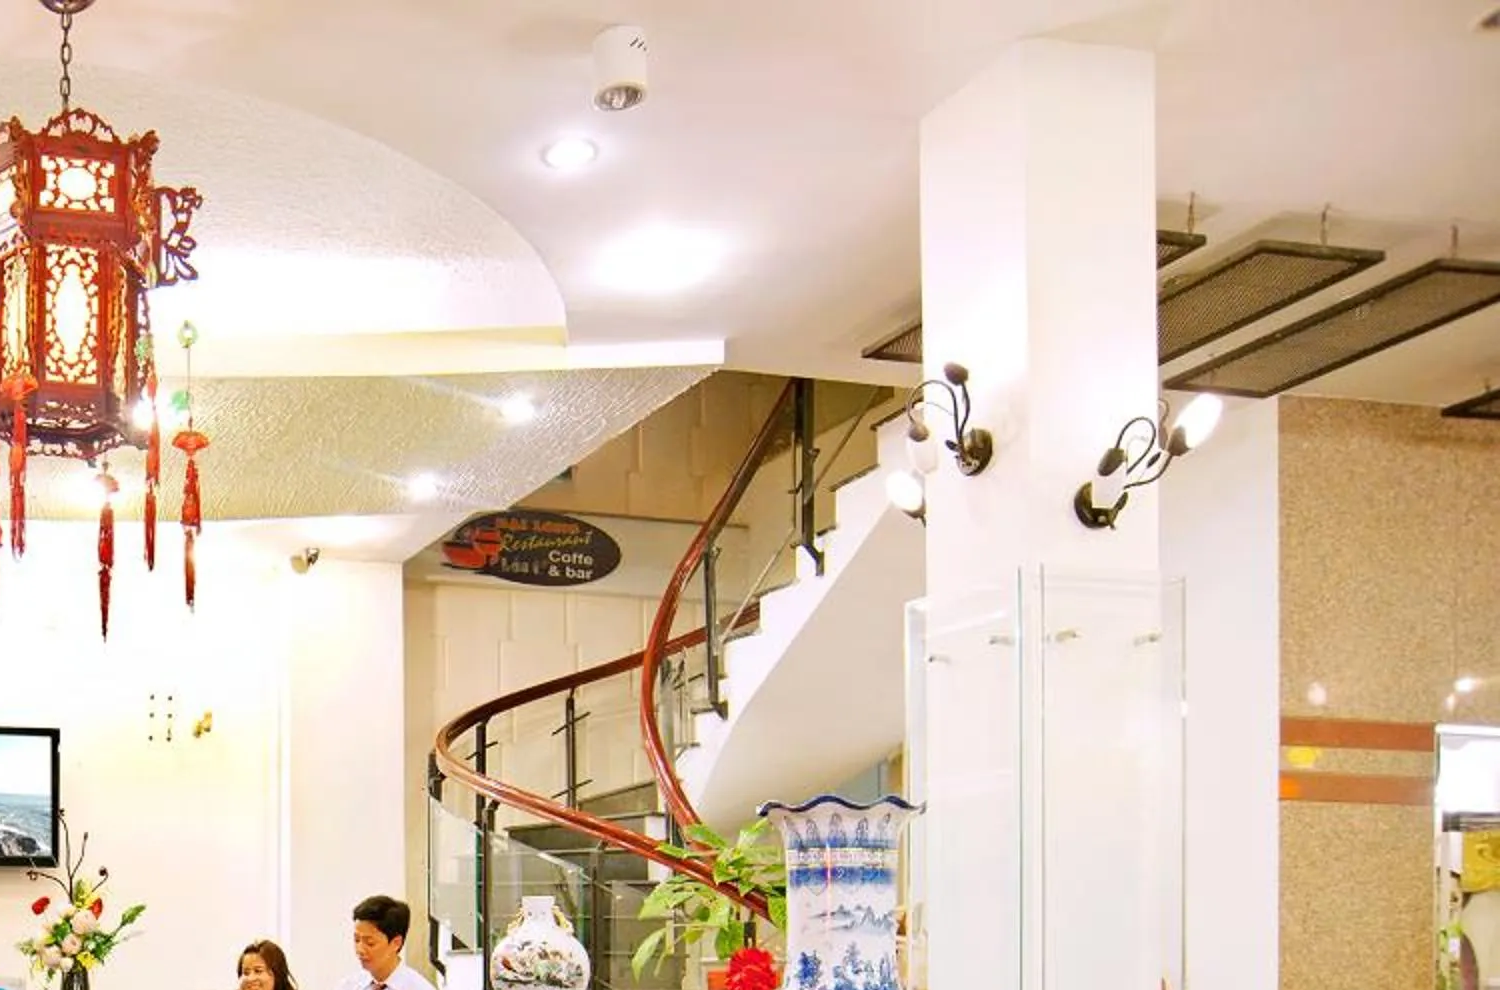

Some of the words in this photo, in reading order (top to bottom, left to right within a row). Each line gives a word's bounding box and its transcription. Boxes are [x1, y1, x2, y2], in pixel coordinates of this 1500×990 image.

[500, 530, 593, 552] Restaurant
[548, 550, 593, 566] Coffe
[548, 565, 561, 578] &
[565, 564, 593, 580] bar
